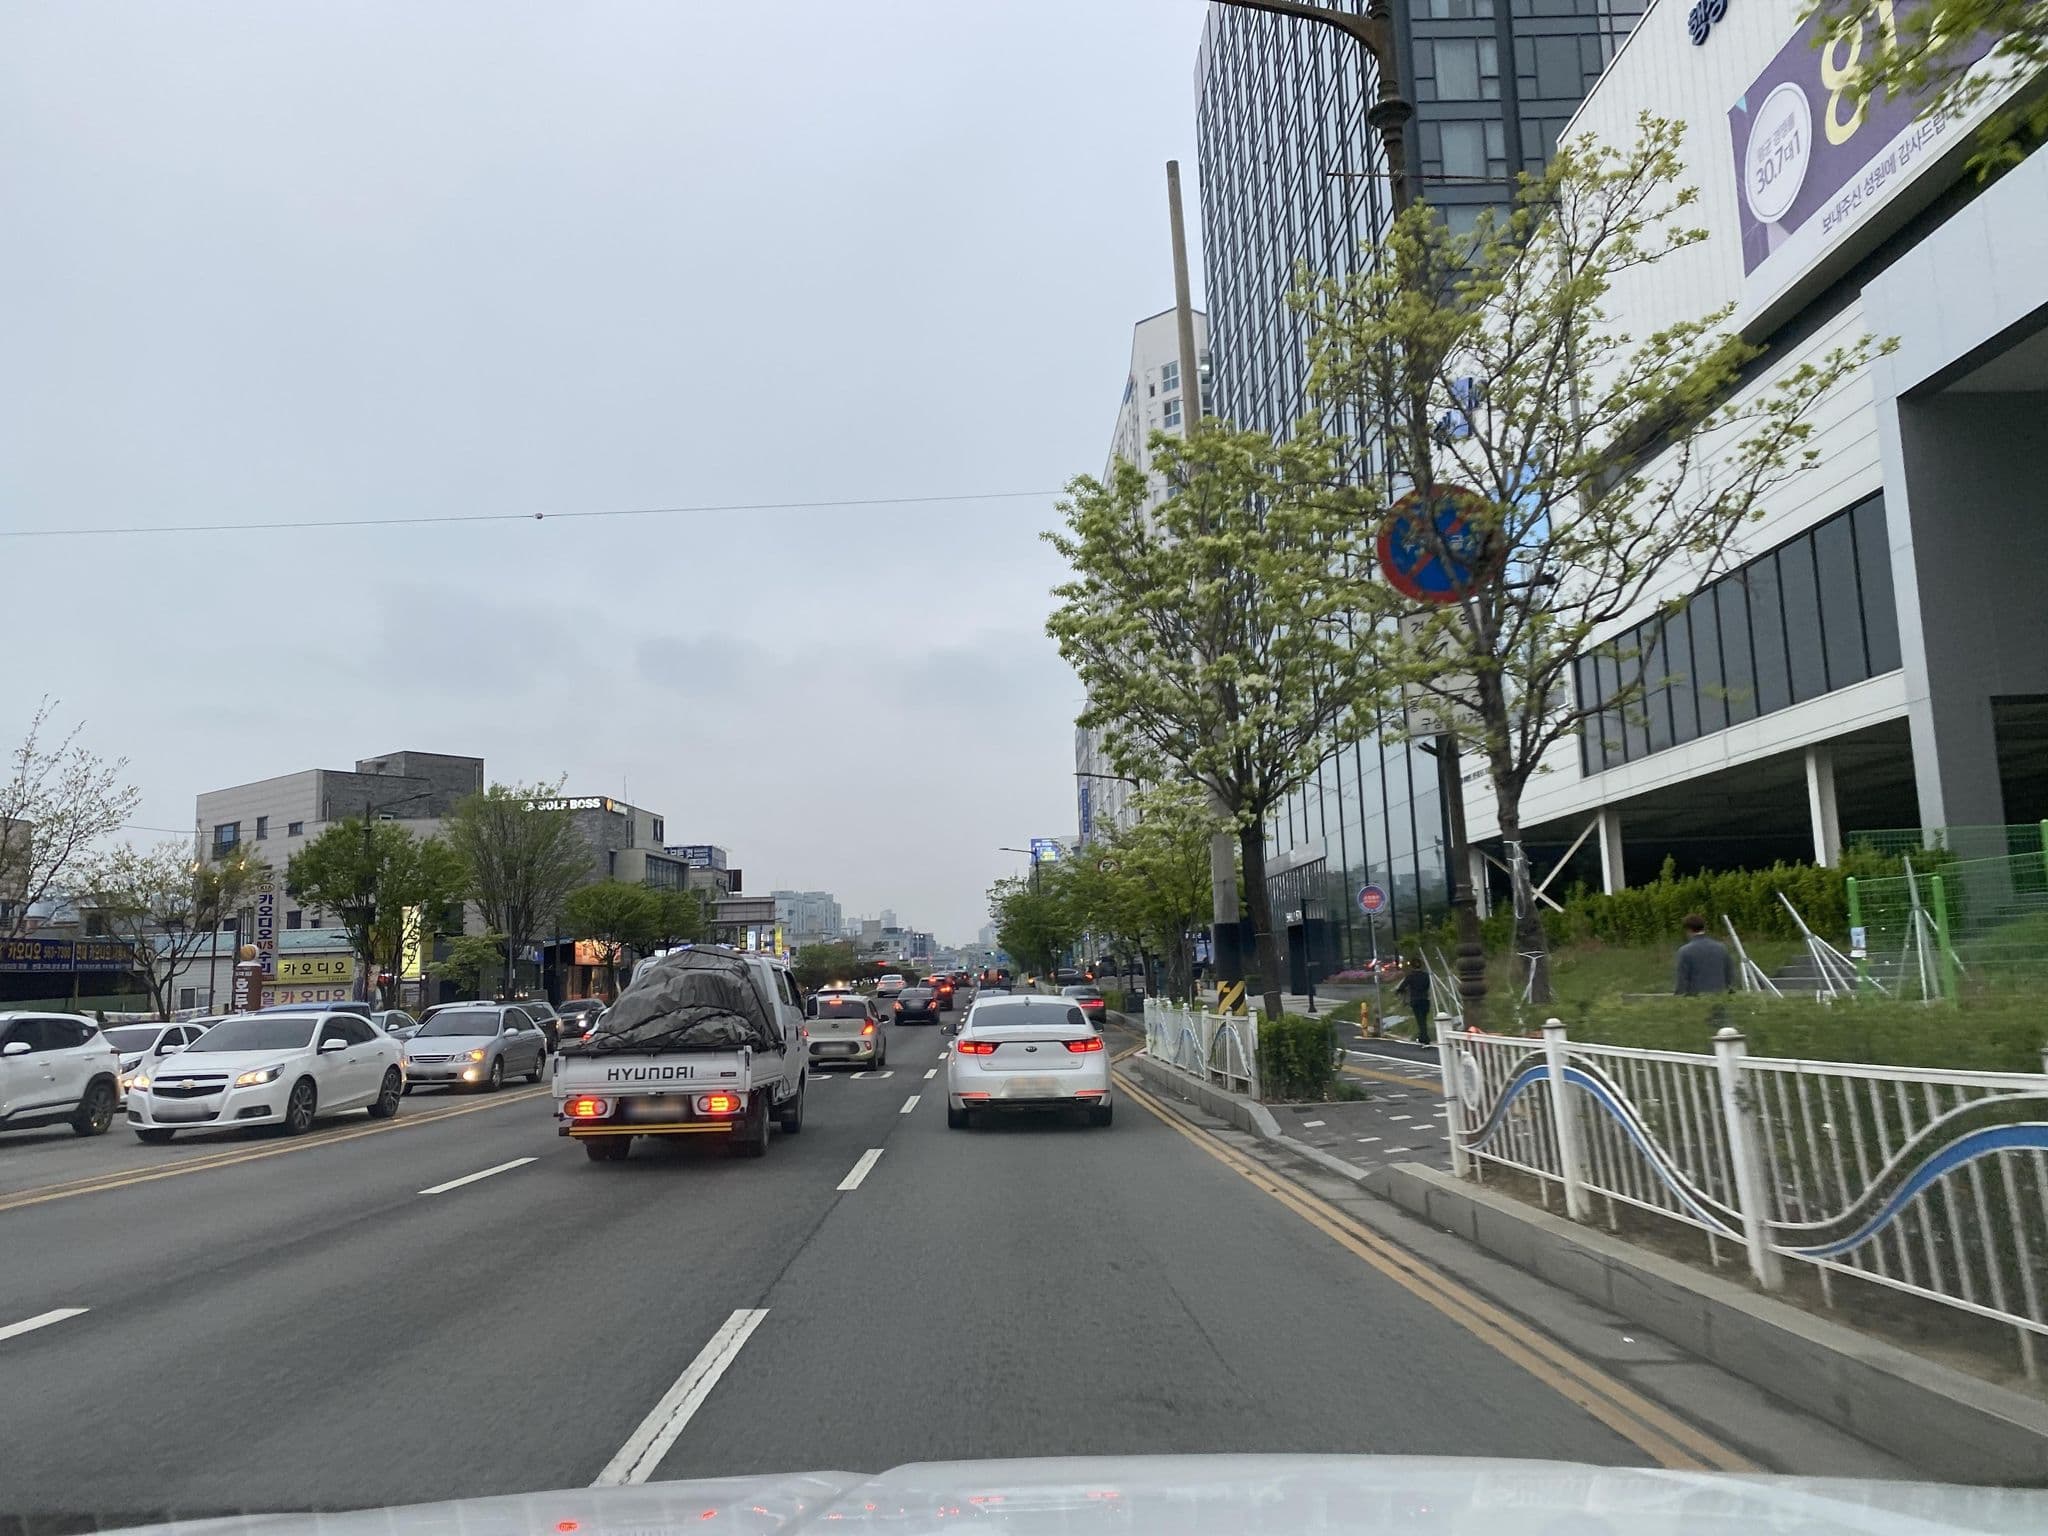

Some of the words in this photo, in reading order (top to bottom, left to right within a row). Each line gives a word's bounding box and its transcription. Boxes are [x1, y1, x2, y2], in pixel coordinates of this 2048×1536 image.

[1756, 130, 1801, 195] 30.7대1
[1822, 186, 1863, 235] 보내주신
[1863, 152, 1897, 196] 성원에
[537, 800, 567, 811] GOLF
[569, 797, 601, 810] BOSS
[258, 894, 274, 940] 카오디오
[7, 942, 42, 960] 카오디오
[257, 940, 273, 950] A/S
[284, 961, 346, 976] 카오디오
[608, 1066, 694, 1081] HYUNDAI
